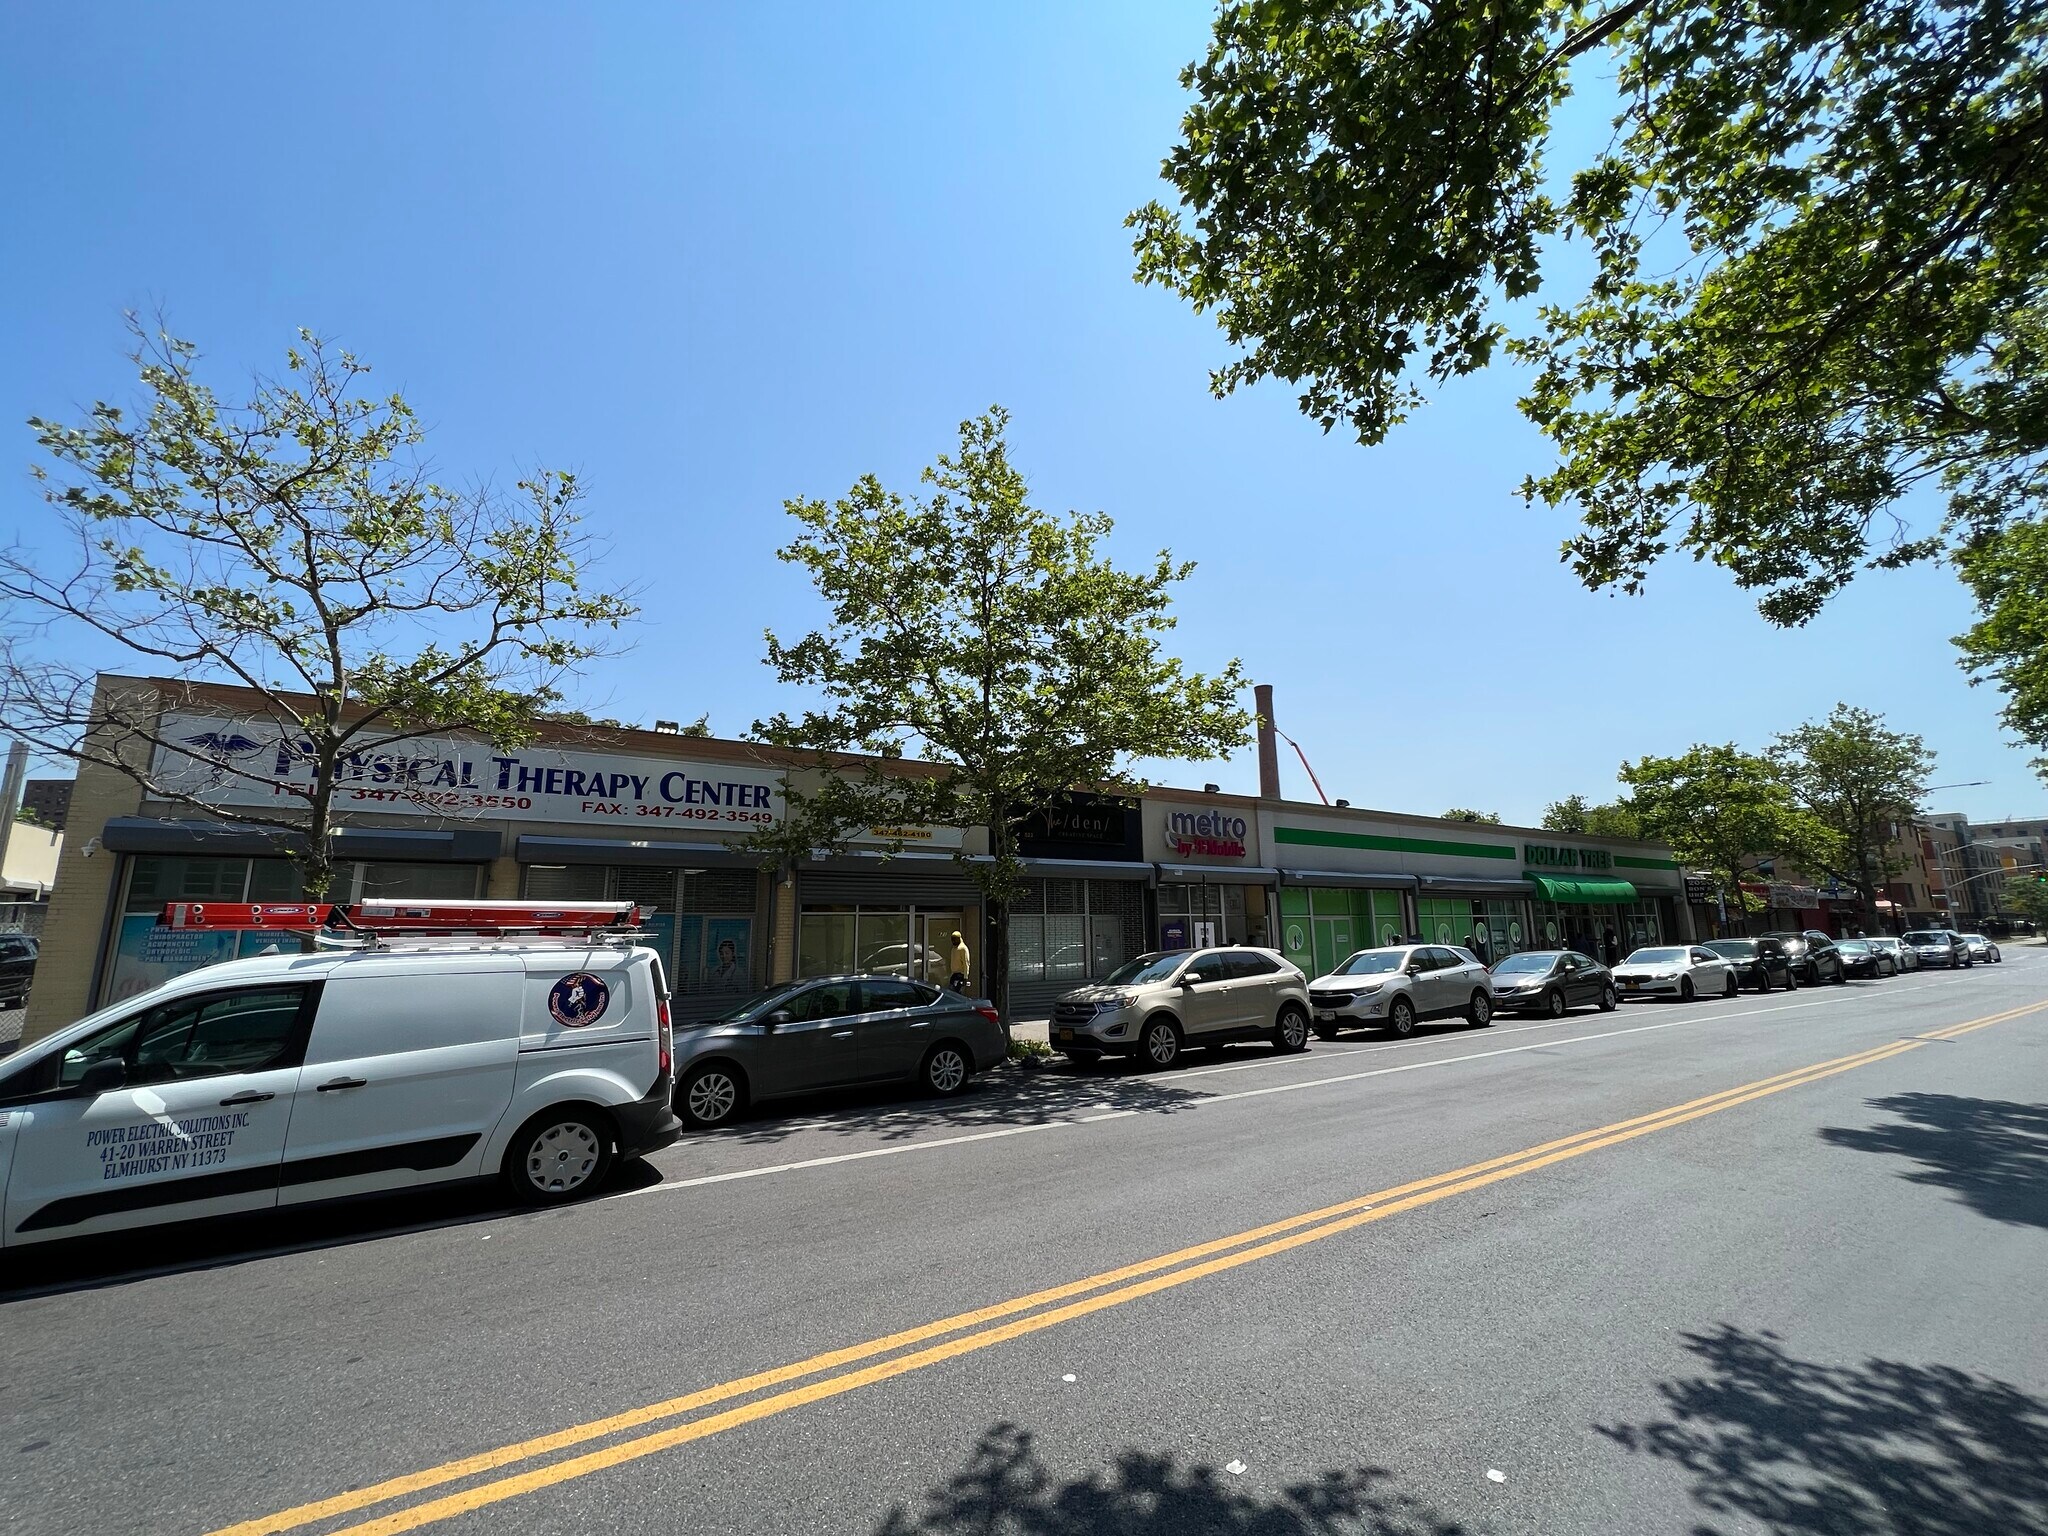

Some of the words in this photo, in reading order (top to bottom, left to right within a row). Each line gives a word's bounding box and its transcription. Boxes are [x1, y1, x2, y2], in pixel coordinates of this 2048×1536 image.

[492, 757, 650, 800] THERAPY
[659, 771, 771, 809] CENTER
[350, 788, 532, 810] 347-492-3550
[582, 801, 629, 816] FAX:
[636, 804, 773, 824] 347-492-3549
[1171, 810, 1247, 839] metro
[1525, 845, 1579, 867] DOLLAR
[1581, 849, 1613, 869] TREE
[87, 1126, 125, 1147] POWER
[127, 1121, 176, 1142] ELECTRIC
[177, 1114, 231, 1135] SOLUTIONS
[232, 1112, 250, 1129] INC.
[100, 1143, 135, 1163] 41-20
[137, 1137, 190, 1155] WARREN
[190, 1130, 235, 1150] STREET
[104, 1155, 171, 1180] ELMHURST
[171, 1153, 191, 1171] NY
[191, 1148, 227, 1168] 11373
